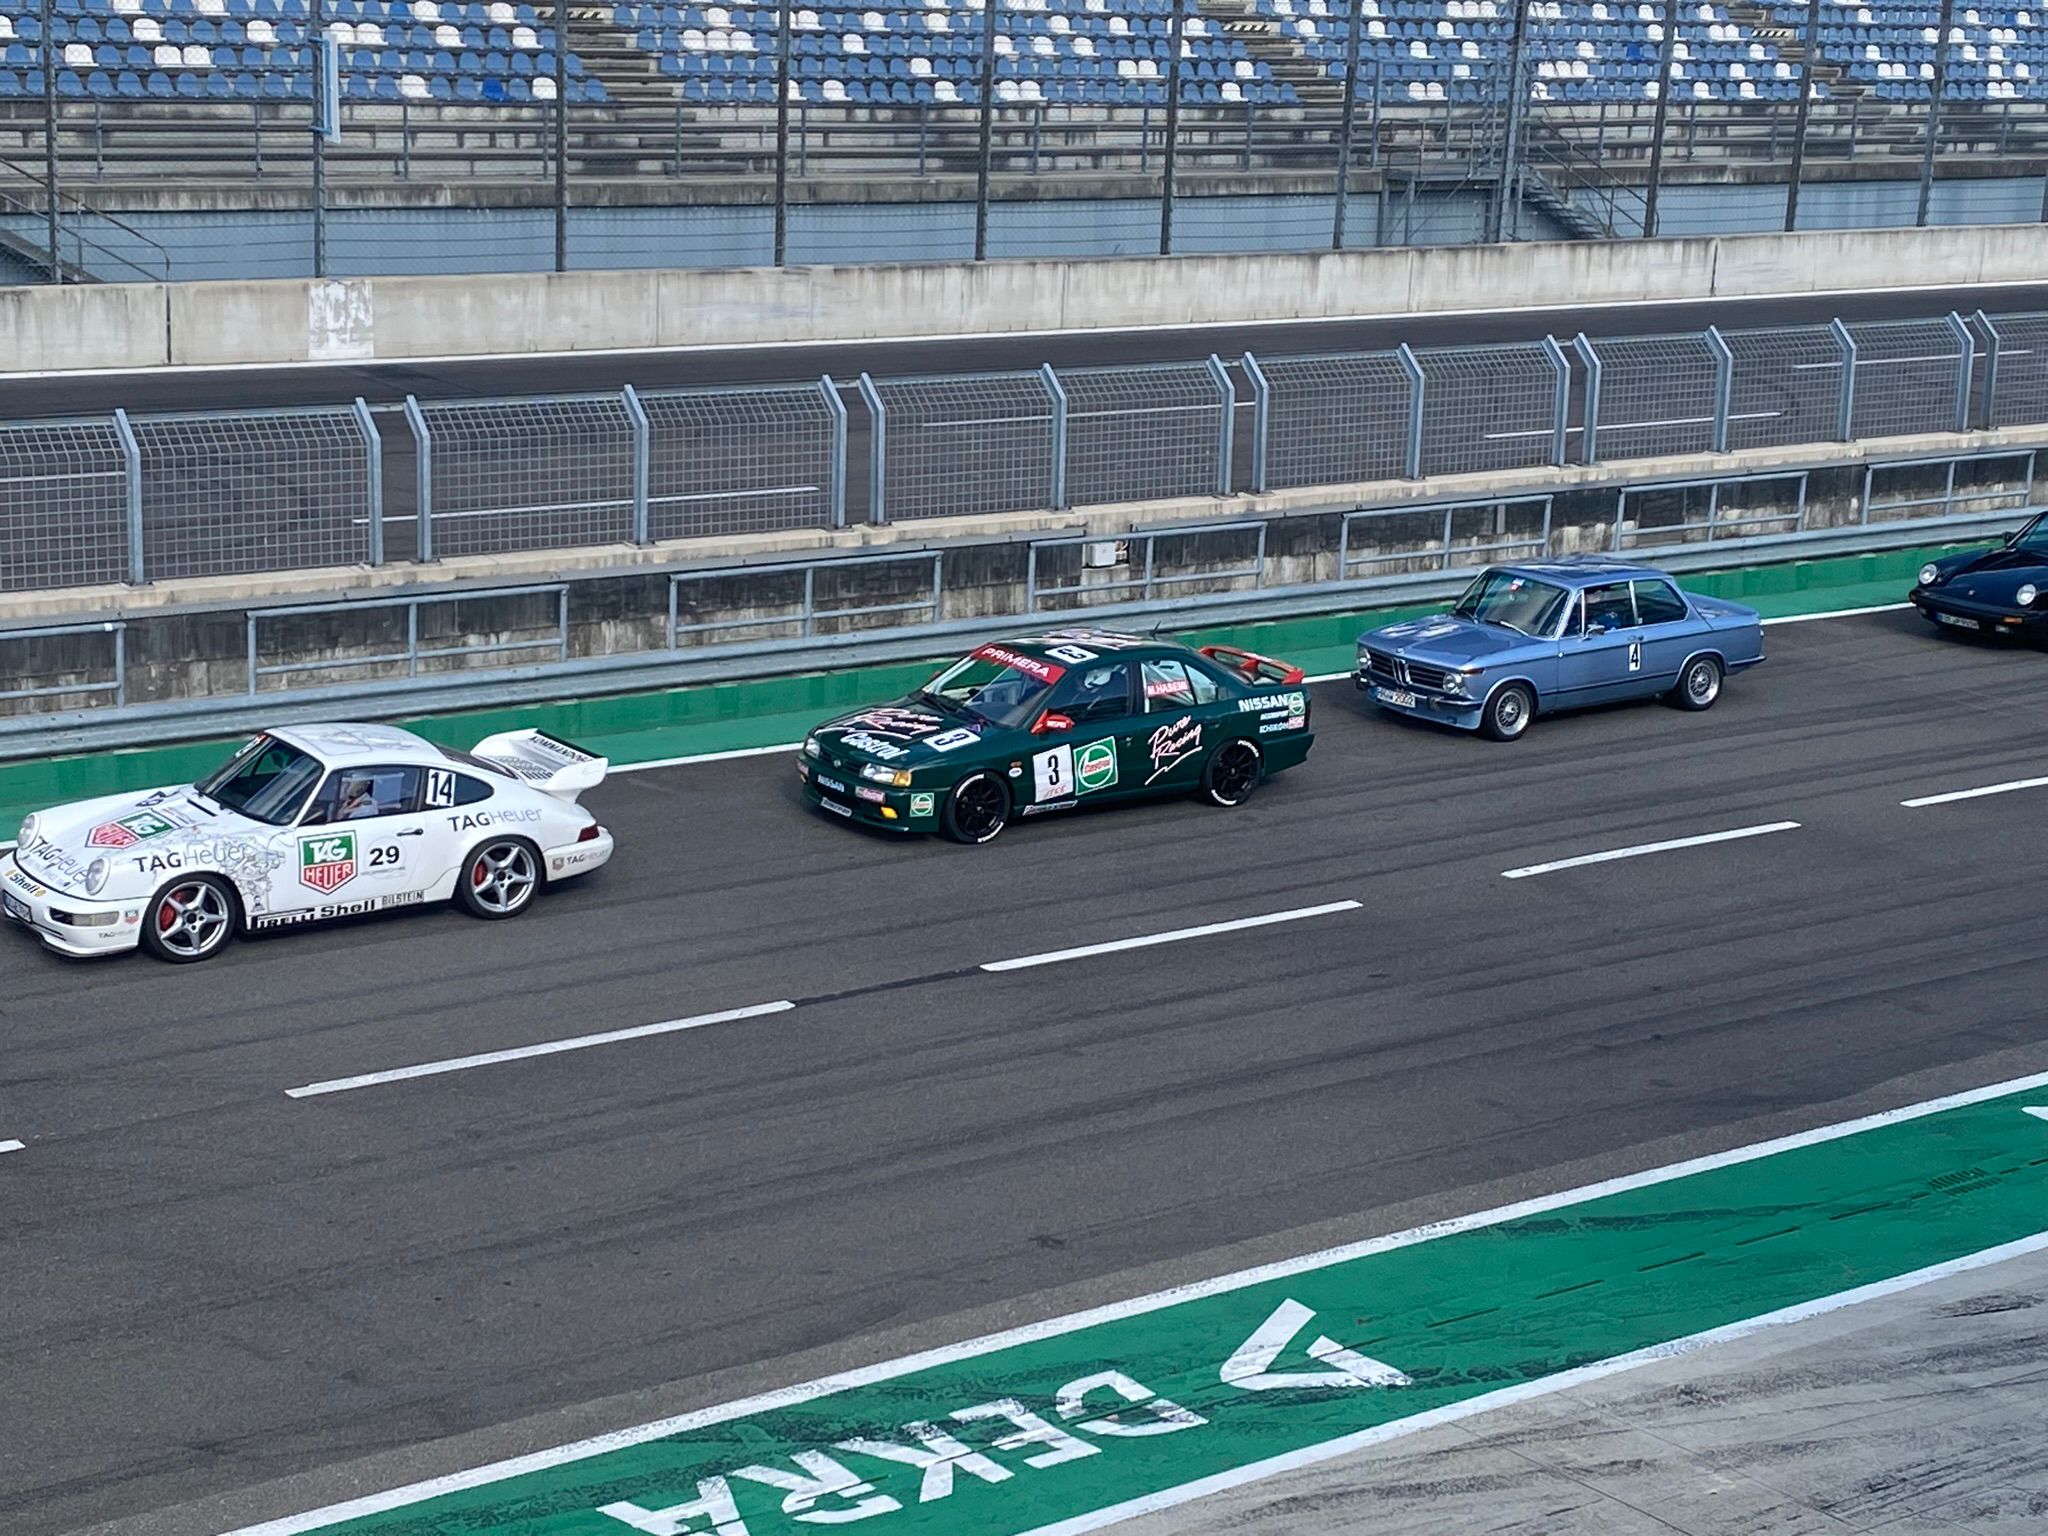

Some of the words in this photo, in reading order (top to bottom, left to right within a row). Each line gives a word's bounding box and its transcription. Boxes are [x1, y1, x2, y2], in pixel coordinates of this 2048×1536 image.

[982, 647, 1050, 677] PRIMERA
[1630, 643, 1640, 668] 4
[1238, 694, 1290, 713] NISSAN
[840, 732, 911, 760] Castrol
[1047, 755, 1060, 785] 3
[431, 771, 453, 804] 14
[309, 838, 347, 863] TAG
[369, 845, 400, 867] 29
[9, 873, 40, 894] Shell
[305, 863, 352, 888] HEUER
[321, 899, 376, 918] Shell
[381, 891, 425, 908] BILSTEIN
